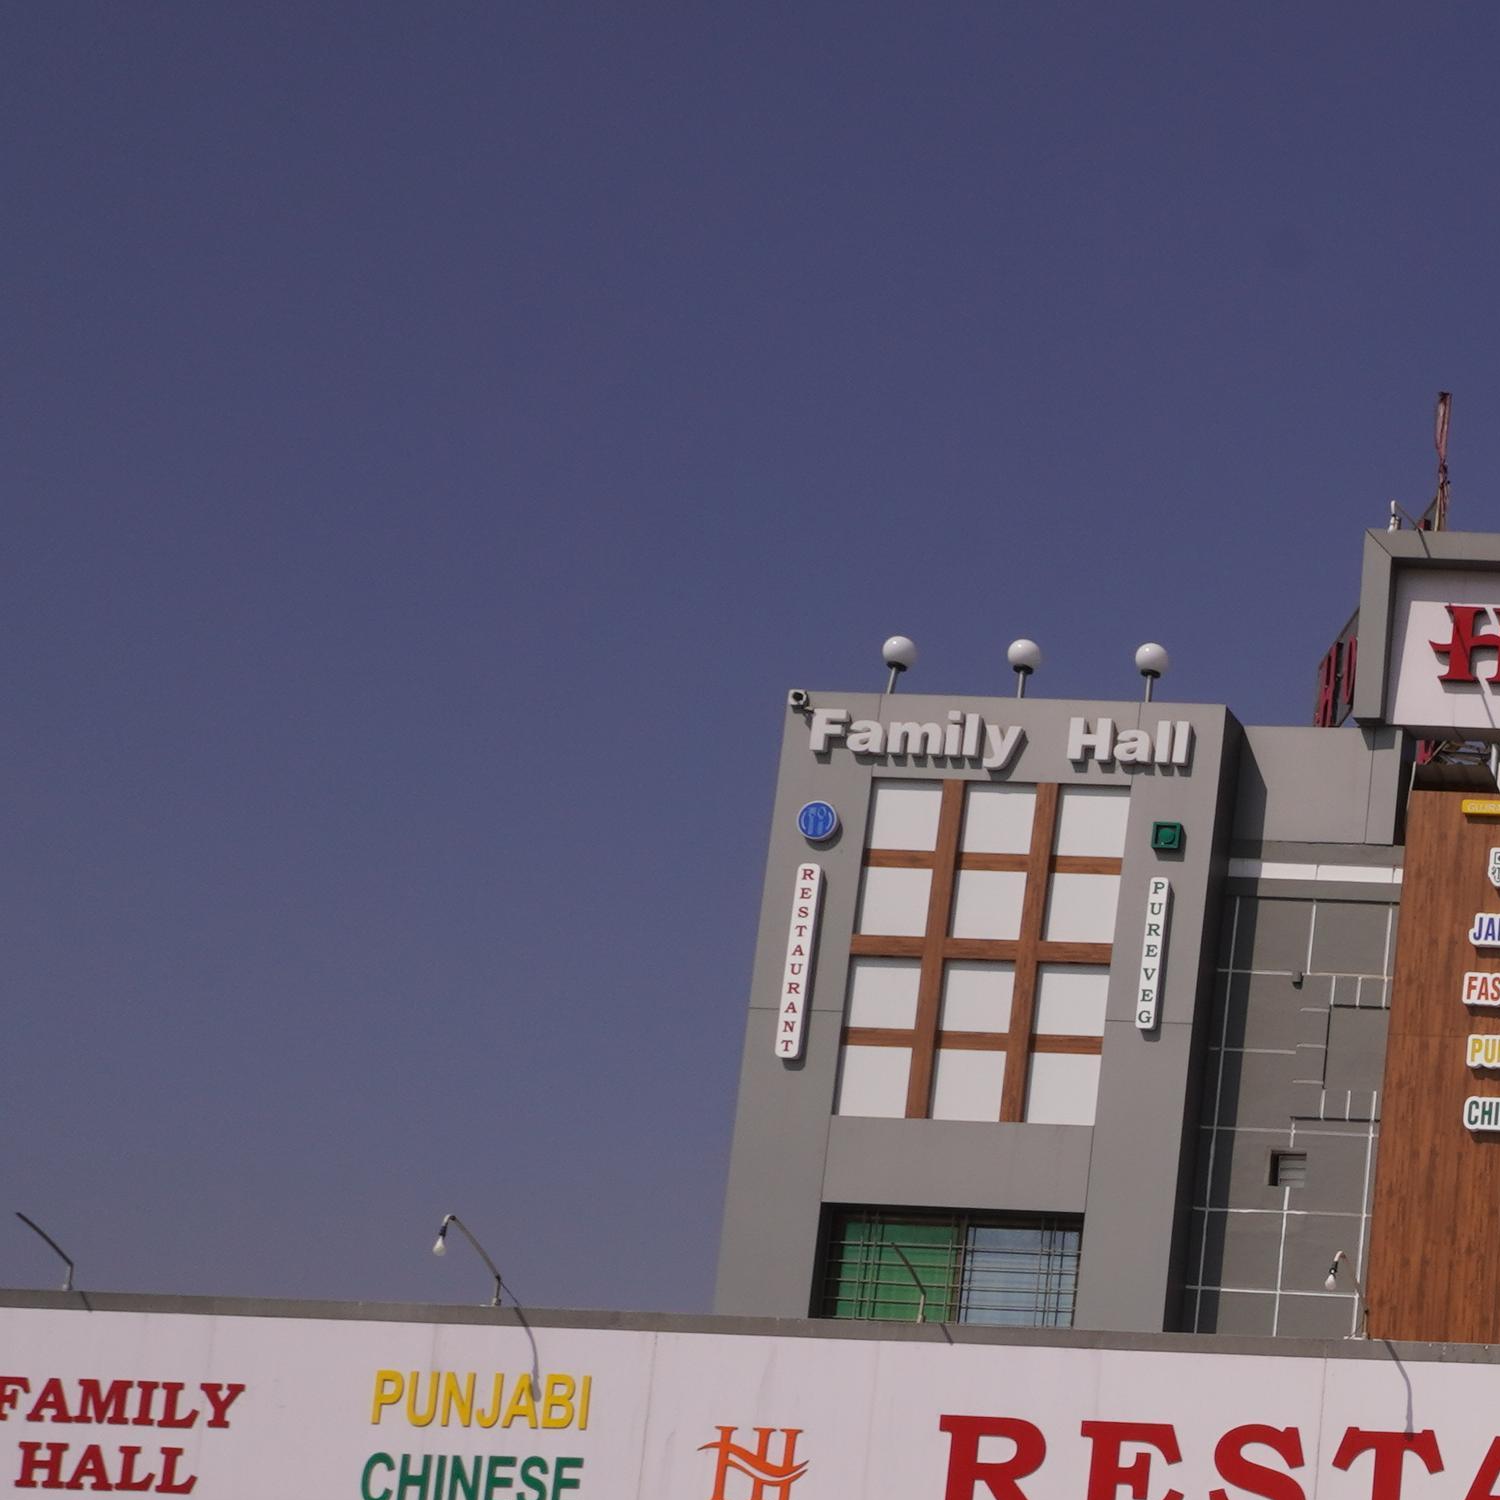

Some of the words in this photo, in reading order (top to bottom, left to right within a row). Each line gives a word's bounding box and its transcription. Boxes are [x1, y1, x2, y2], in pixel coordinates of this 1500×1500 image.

[809, 708, 1025, 769] Family
[1066, 716, 1191, 766] Hall
[780, 867, 816, 1054] RESTAURANT
[0, 1375, 246, 1429] FAMILY
[371, 1370, 592, 1431] PUNJABI
[14, 1441, 198, 1494] HALL
